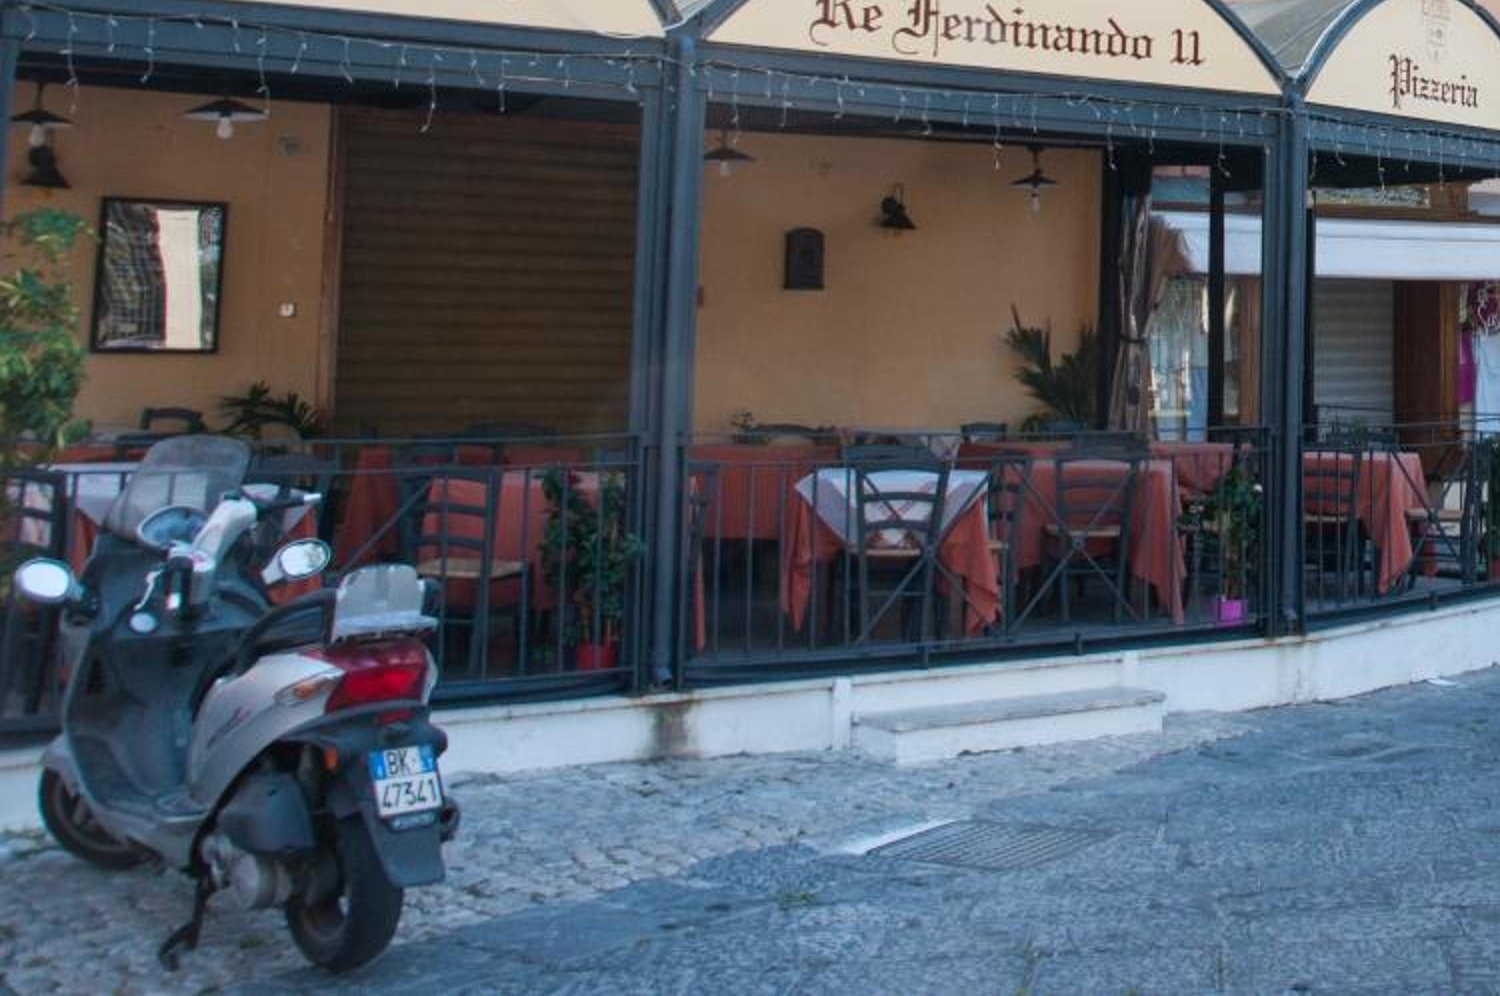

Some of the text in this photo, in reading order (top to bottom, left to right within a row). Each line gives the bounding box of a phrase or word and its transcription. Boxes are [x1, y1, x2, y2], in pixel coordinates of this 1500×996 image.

[1389, 54, 1479, 108] Pizzeria
[385, 747, 412, 776] BK
[382, 778, 438, 808] 47341
